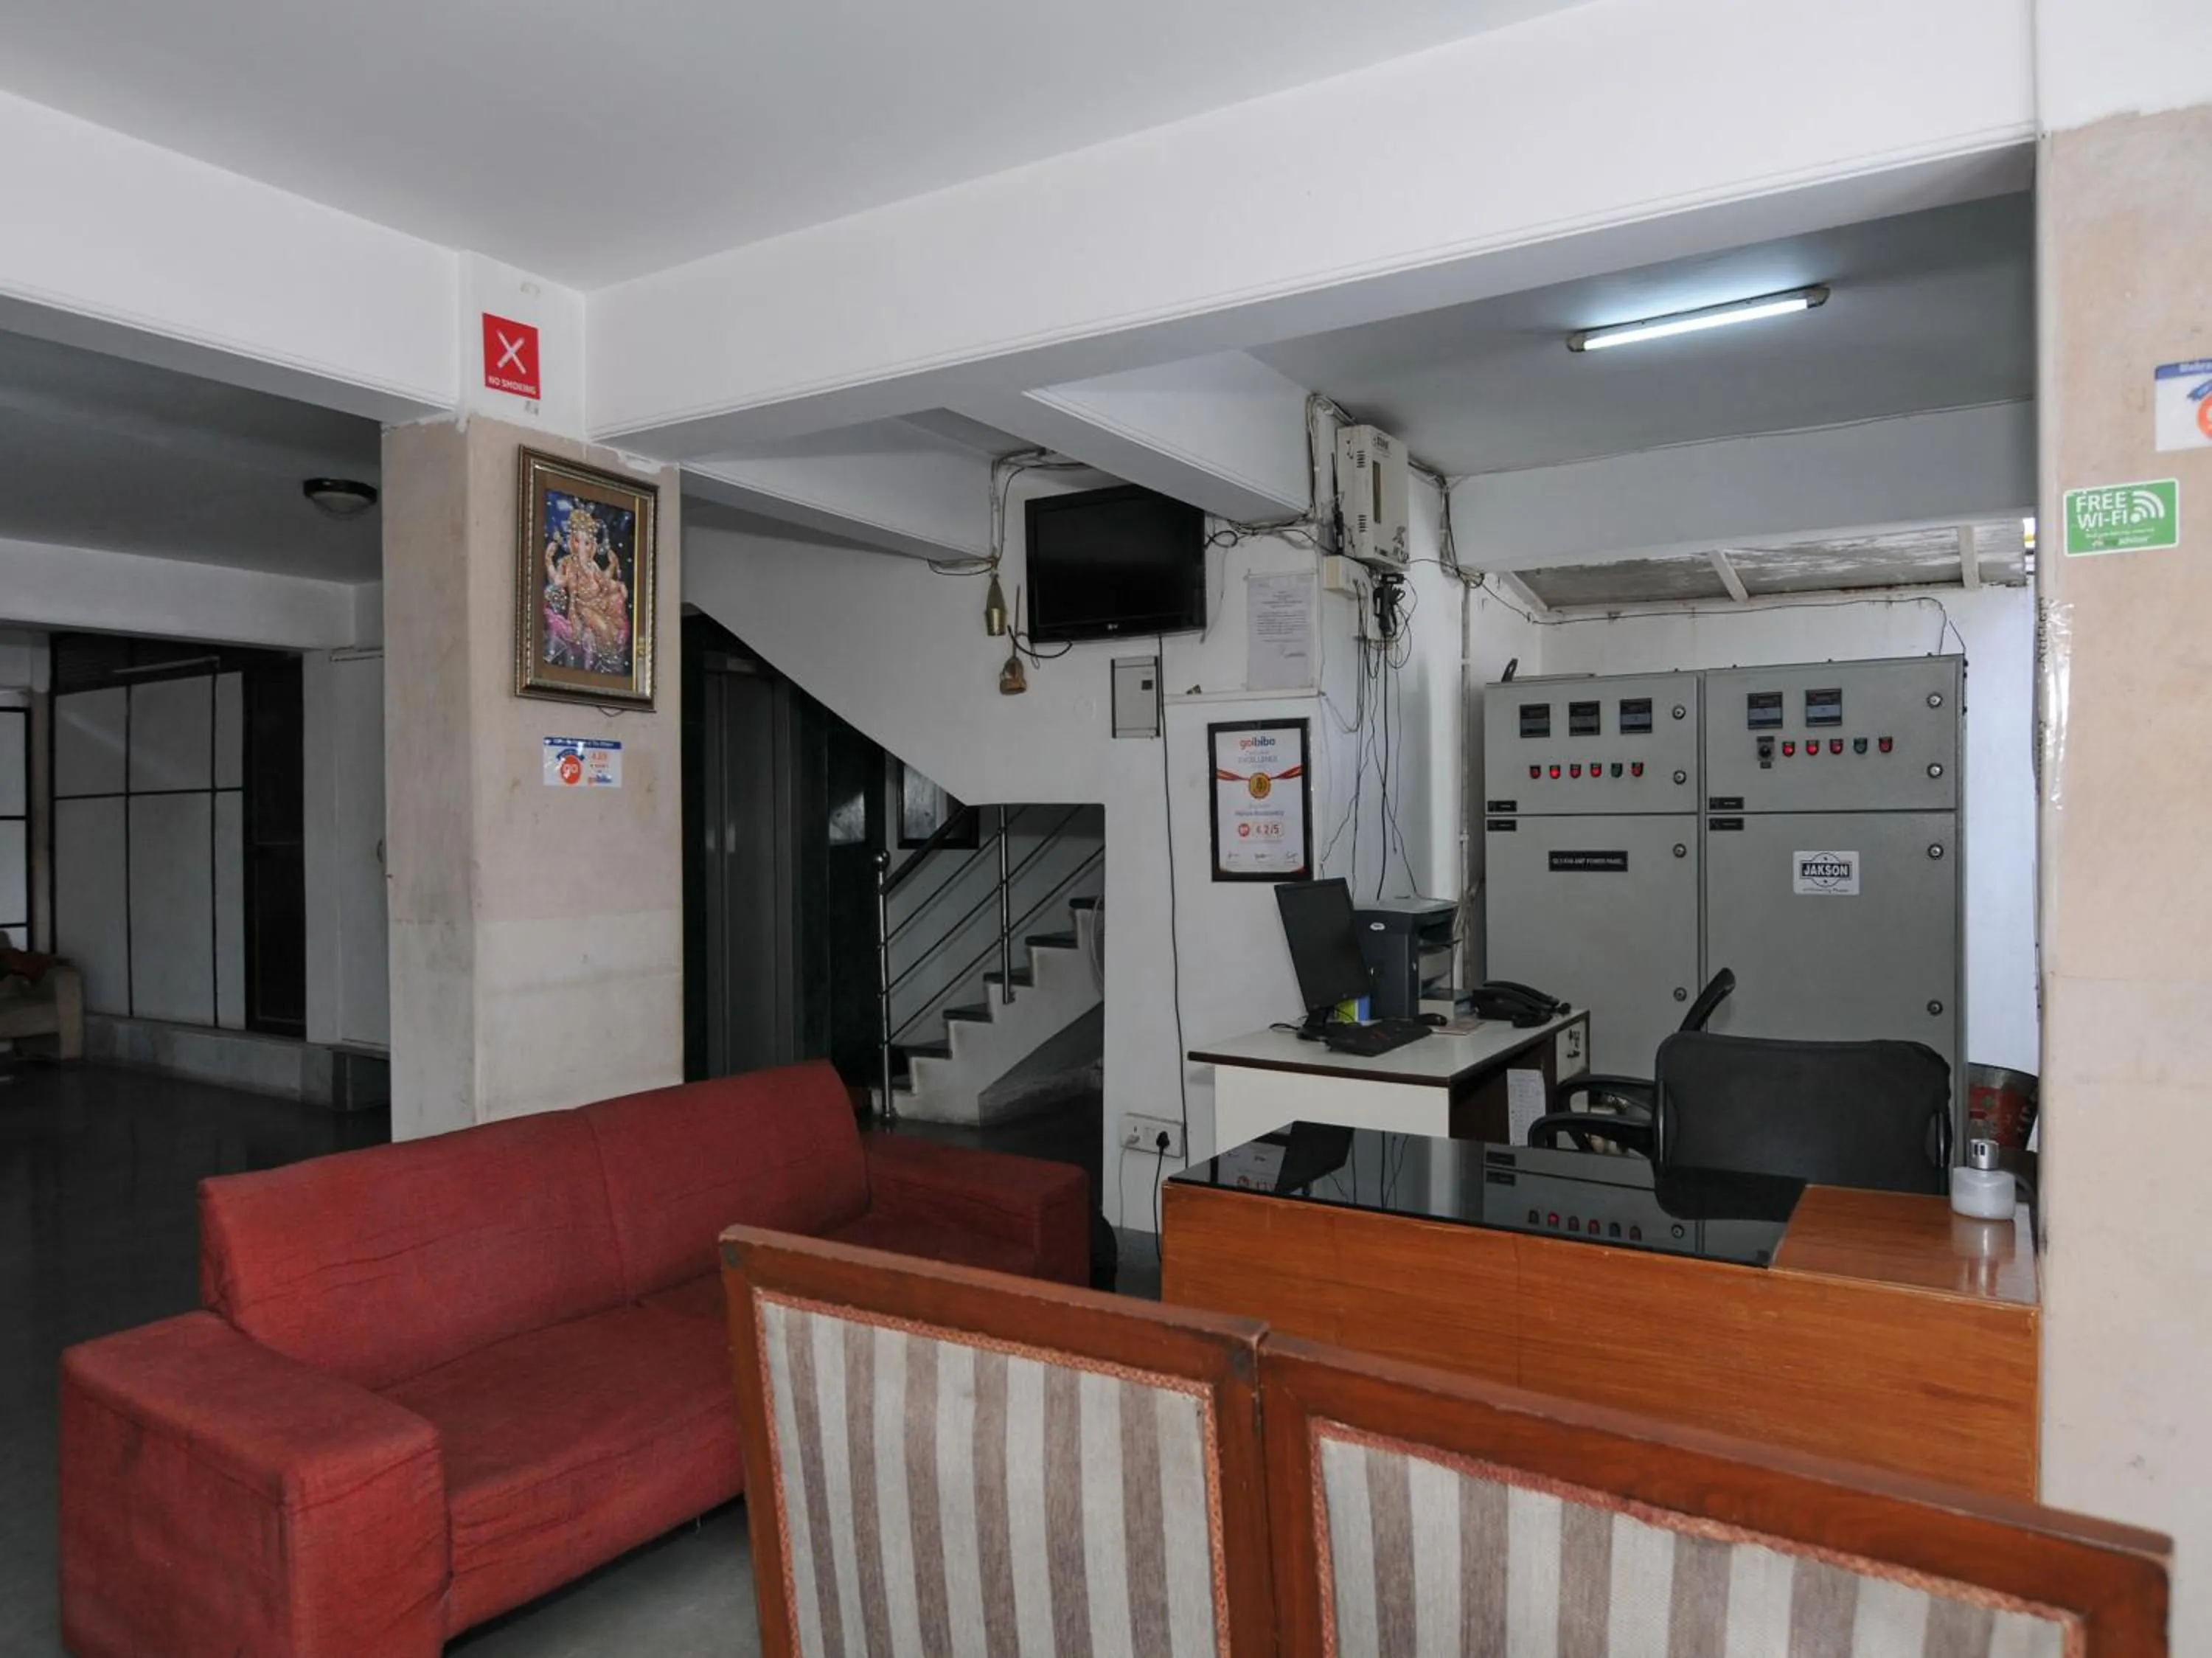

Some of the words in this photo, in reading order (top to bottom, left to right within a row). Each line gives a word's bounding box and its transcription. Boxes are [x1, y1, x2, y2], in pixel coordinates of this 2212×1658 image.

[488, 375, 501, 386] NO
[501, 378, 537, 395] SMOKING
[2076, 491, 2127, 513] FREE
[2076, 509, 2128, 530] WI-FI
[1239, 736, 1276, 749] goibibo
[1804, 863, 1848, 876] JAKSON
